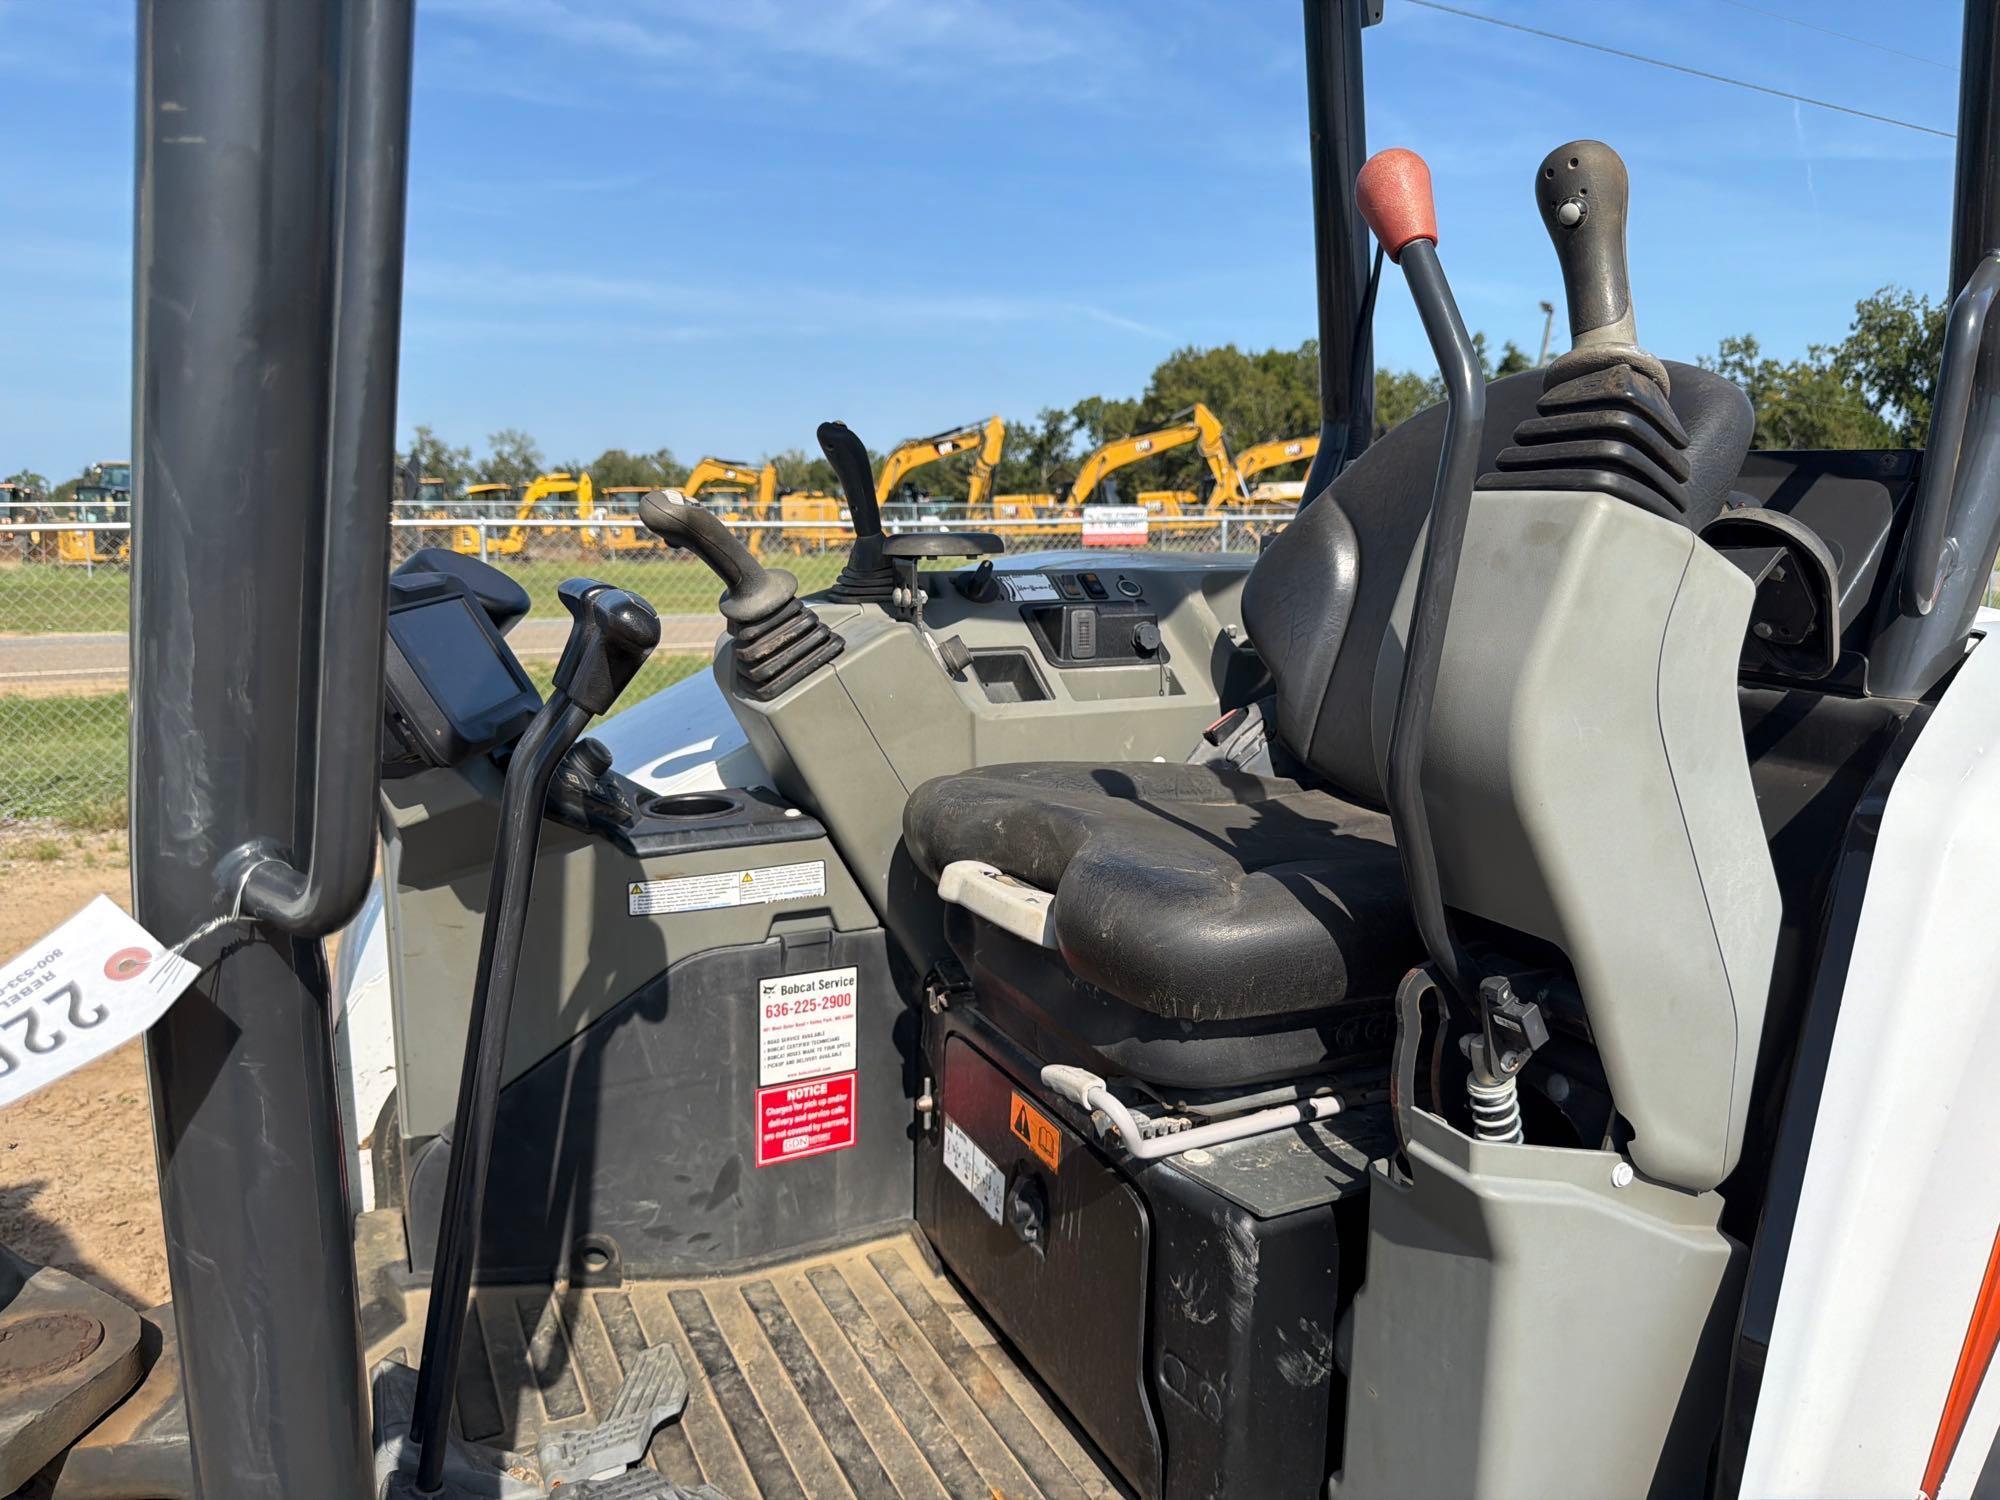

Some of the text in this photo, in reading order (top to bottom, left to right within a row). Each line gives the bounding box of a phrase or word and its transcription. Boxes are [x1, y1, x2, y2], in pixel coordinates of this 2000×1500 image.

[781, 976, 855, 996] Bobcat Service
[765, 993, 851, 1019] 636-225-2900
[781, 1035, 800, 1043] SERVICE
[802, 1031, 825, 1040] AVAILABLE
[786, 1083, 828, 1101] NOTICE
[766, 1105, 793, 1117] Charges
[804, 1099, 818, 1110] pick
[818, 1098, 827, 1107] up
[768, 1116, 794, 1128] delivery
[795, 1113, 807, 1123] and
[787, 1124, 812, 1136] covered
[813, 1122, 822, 1132] by
